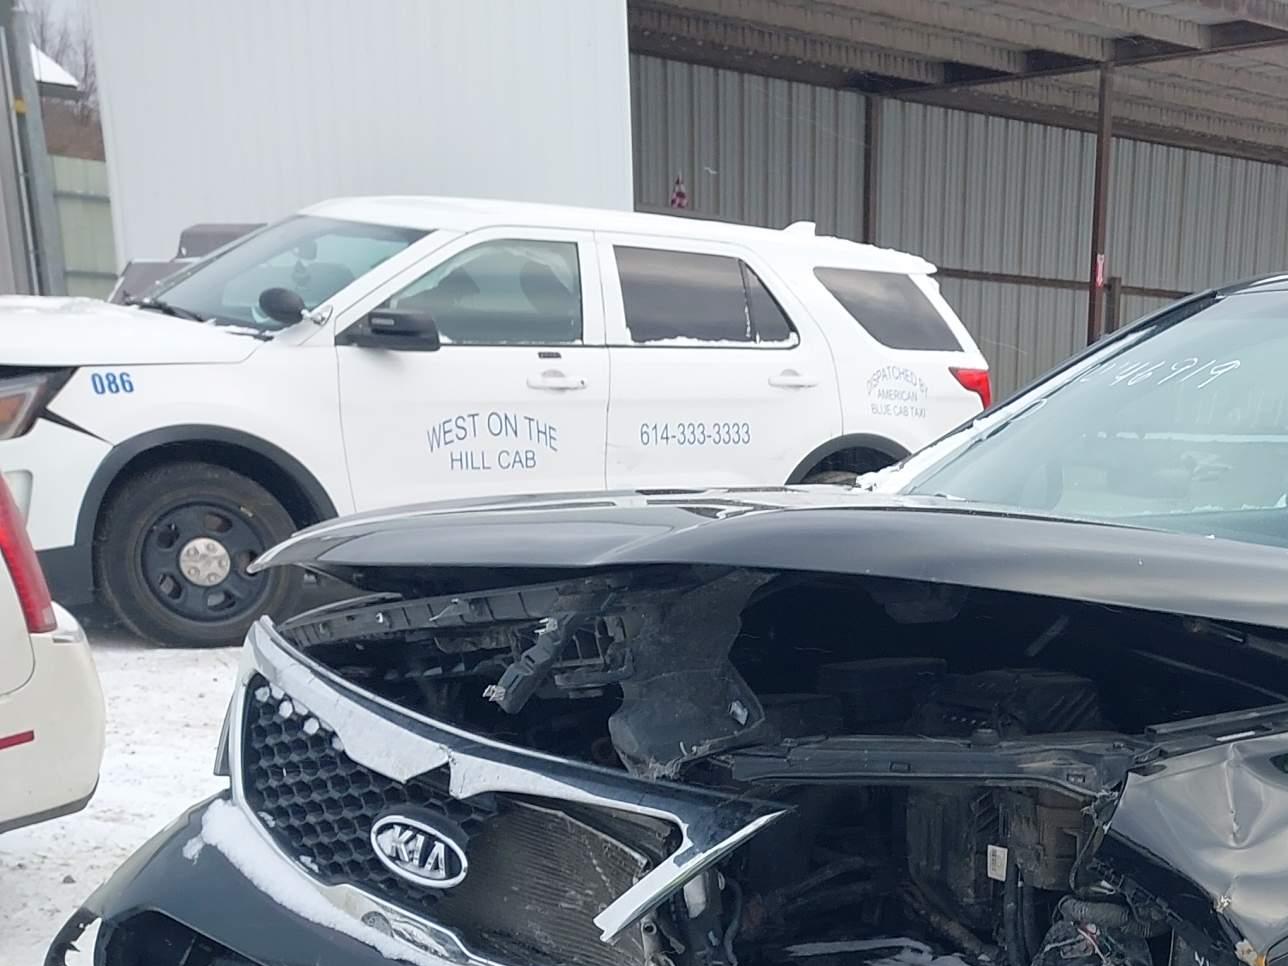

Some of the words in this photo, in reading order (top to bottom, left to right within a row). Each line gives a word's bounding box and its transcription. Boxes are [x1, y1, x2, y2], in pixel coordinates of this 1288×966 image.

[91, 371, 135, 395] 086
[866, 365, 918, 396] DISPATCHED
[877, 388, 918, 402] AMERICAN
[871, 403, 892, 416] BLUE
[893, 405, 910, 417] CAB
[910, 406, 927, 418] TAXI
[426, 413, 480, 453] WEST
[487, 411, 519, 438] ON
[523, 416, 559, 452] THE
[640, 422, 751, 446] 614-333-3333
[450, 450, 492, 471] HILL
[498, 449, 537, 470] CAB
[388, 824, 446, 878] KIA
